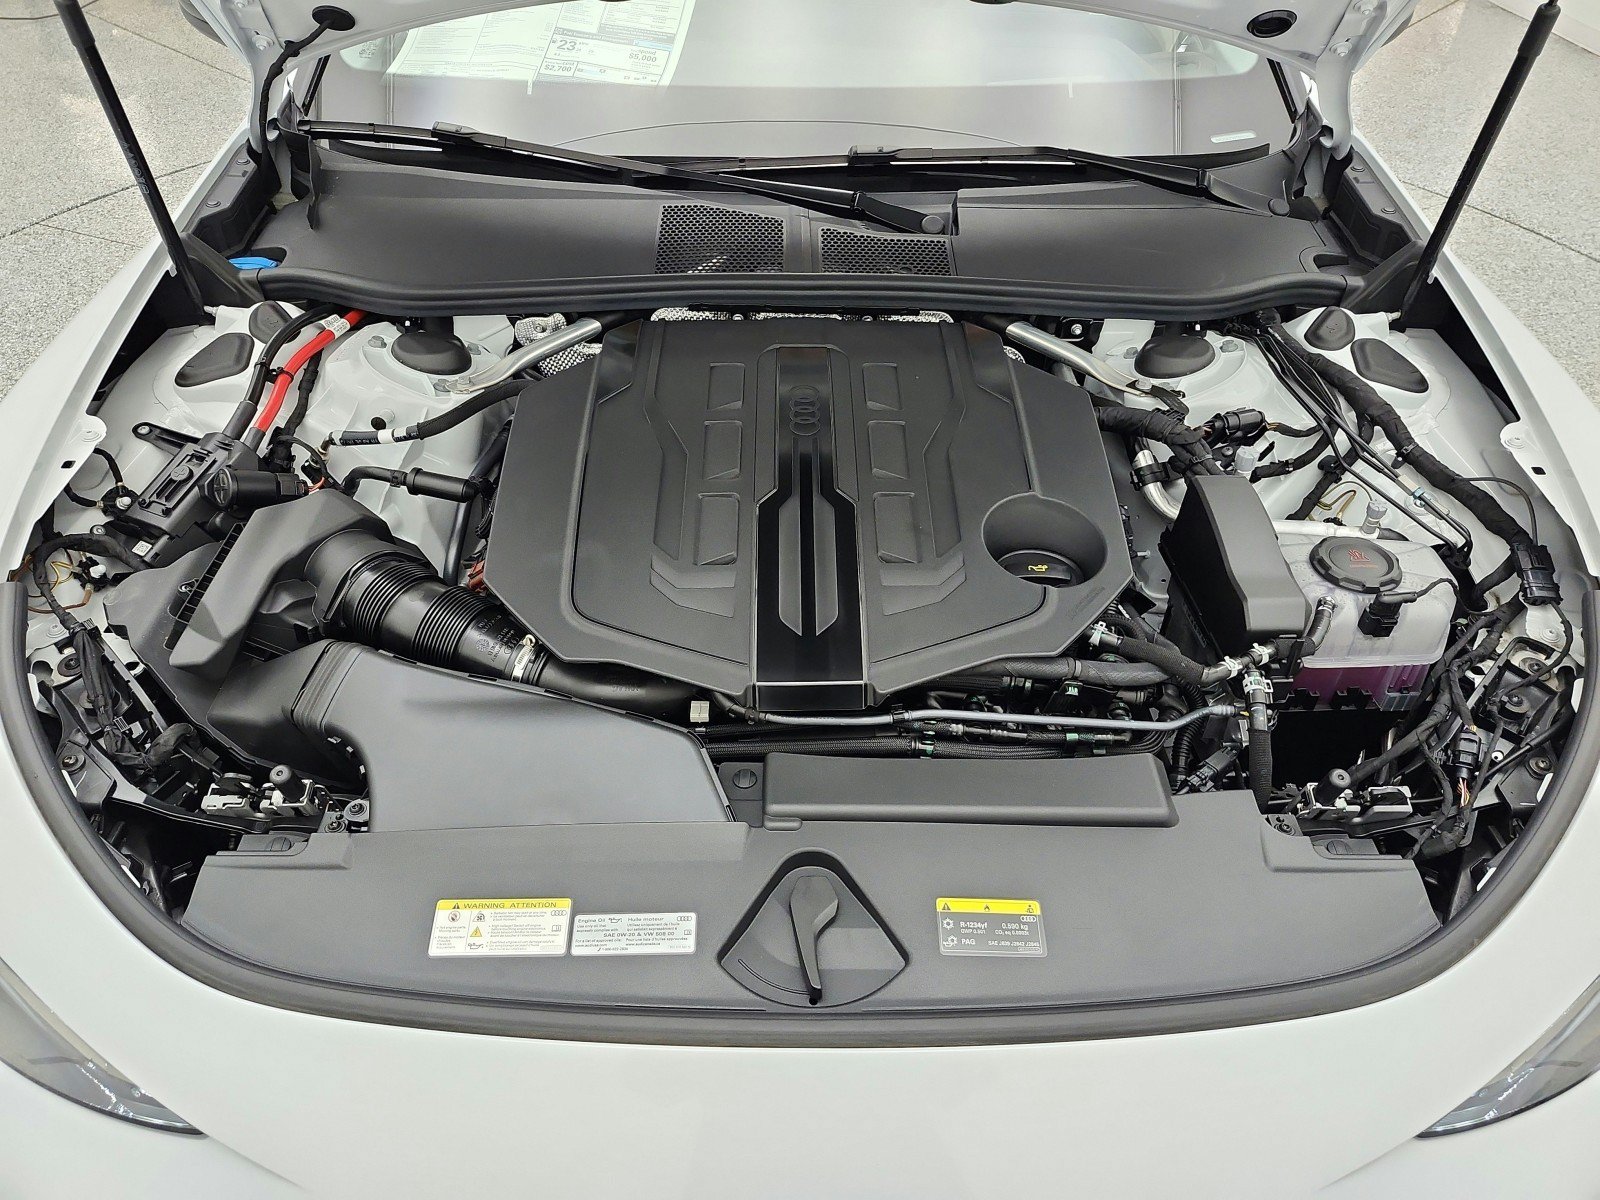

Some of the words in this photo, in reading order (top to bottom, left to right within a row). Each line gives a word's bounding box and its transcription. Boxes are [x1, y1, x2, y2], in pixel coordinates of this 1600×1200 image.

[557, 39, 577, 51] 23
[629, 52, 657, 62] $5,000
[544, 64, 572, 72] $2,700
[463, 902, 505, 910] WARNING
[510, 901, 557, 909] ATTENTION
[960, 921, 988, 930] R-1234yf
